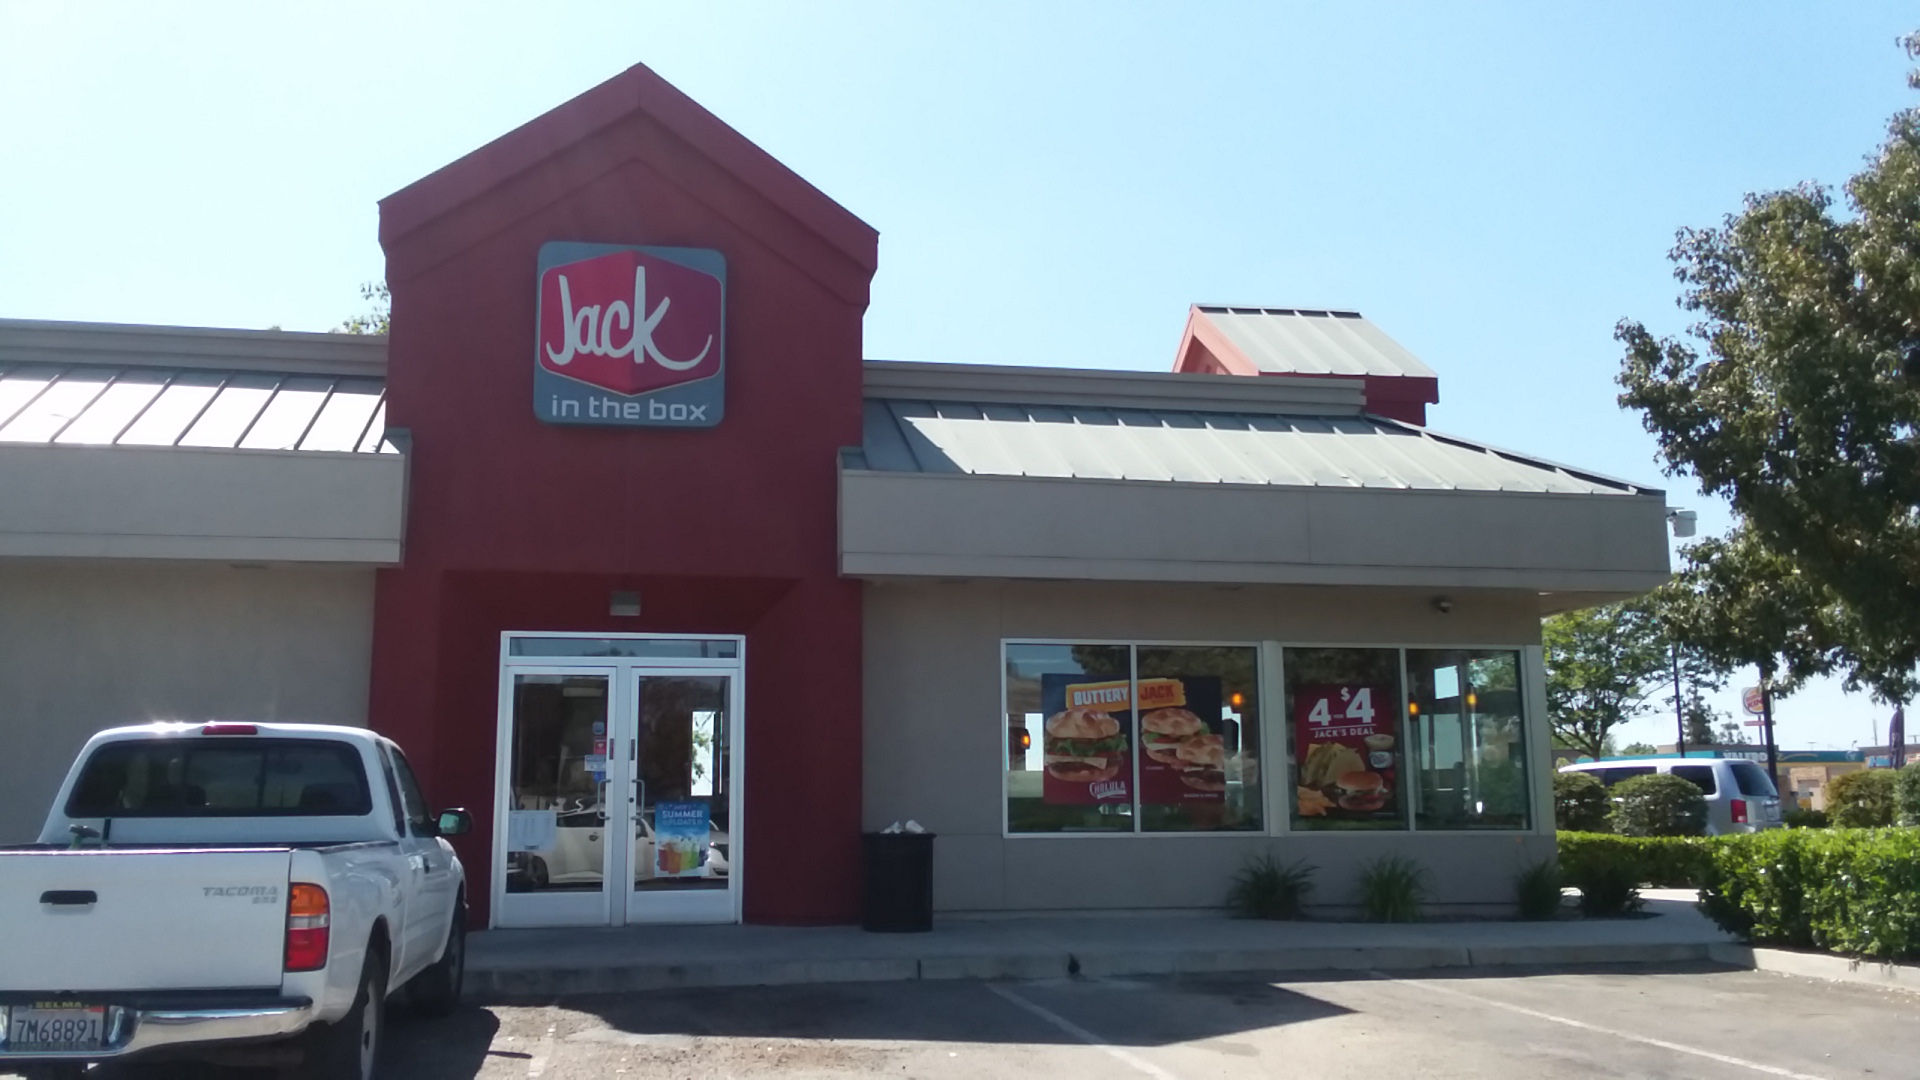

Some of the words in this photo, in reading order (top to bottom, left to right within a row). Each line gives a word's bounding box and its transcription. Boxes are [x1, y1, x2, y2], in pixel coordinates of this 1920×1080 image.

[546, 265, 713, 371] Jack
[552, 395, 579, 417] in
[589, 396, 640, 419] the
[649, 398, 707, 421] box
[1073, 686, 1129, 706] BUTTERY
[1140, 684, 1174, 701] JACK
[1308, 698, 1332, 726] 4
[1314, 728, 1347, 738] JACK'S
[1350, 727, 1375, 736] DEAL
[662, 810, 703, 819] SUMMER
[203, 886, 278, 897] TACOMA
[35, 1001, 82, 1009] SELMA
[15, 1019, 98, 1043] 7M68891
